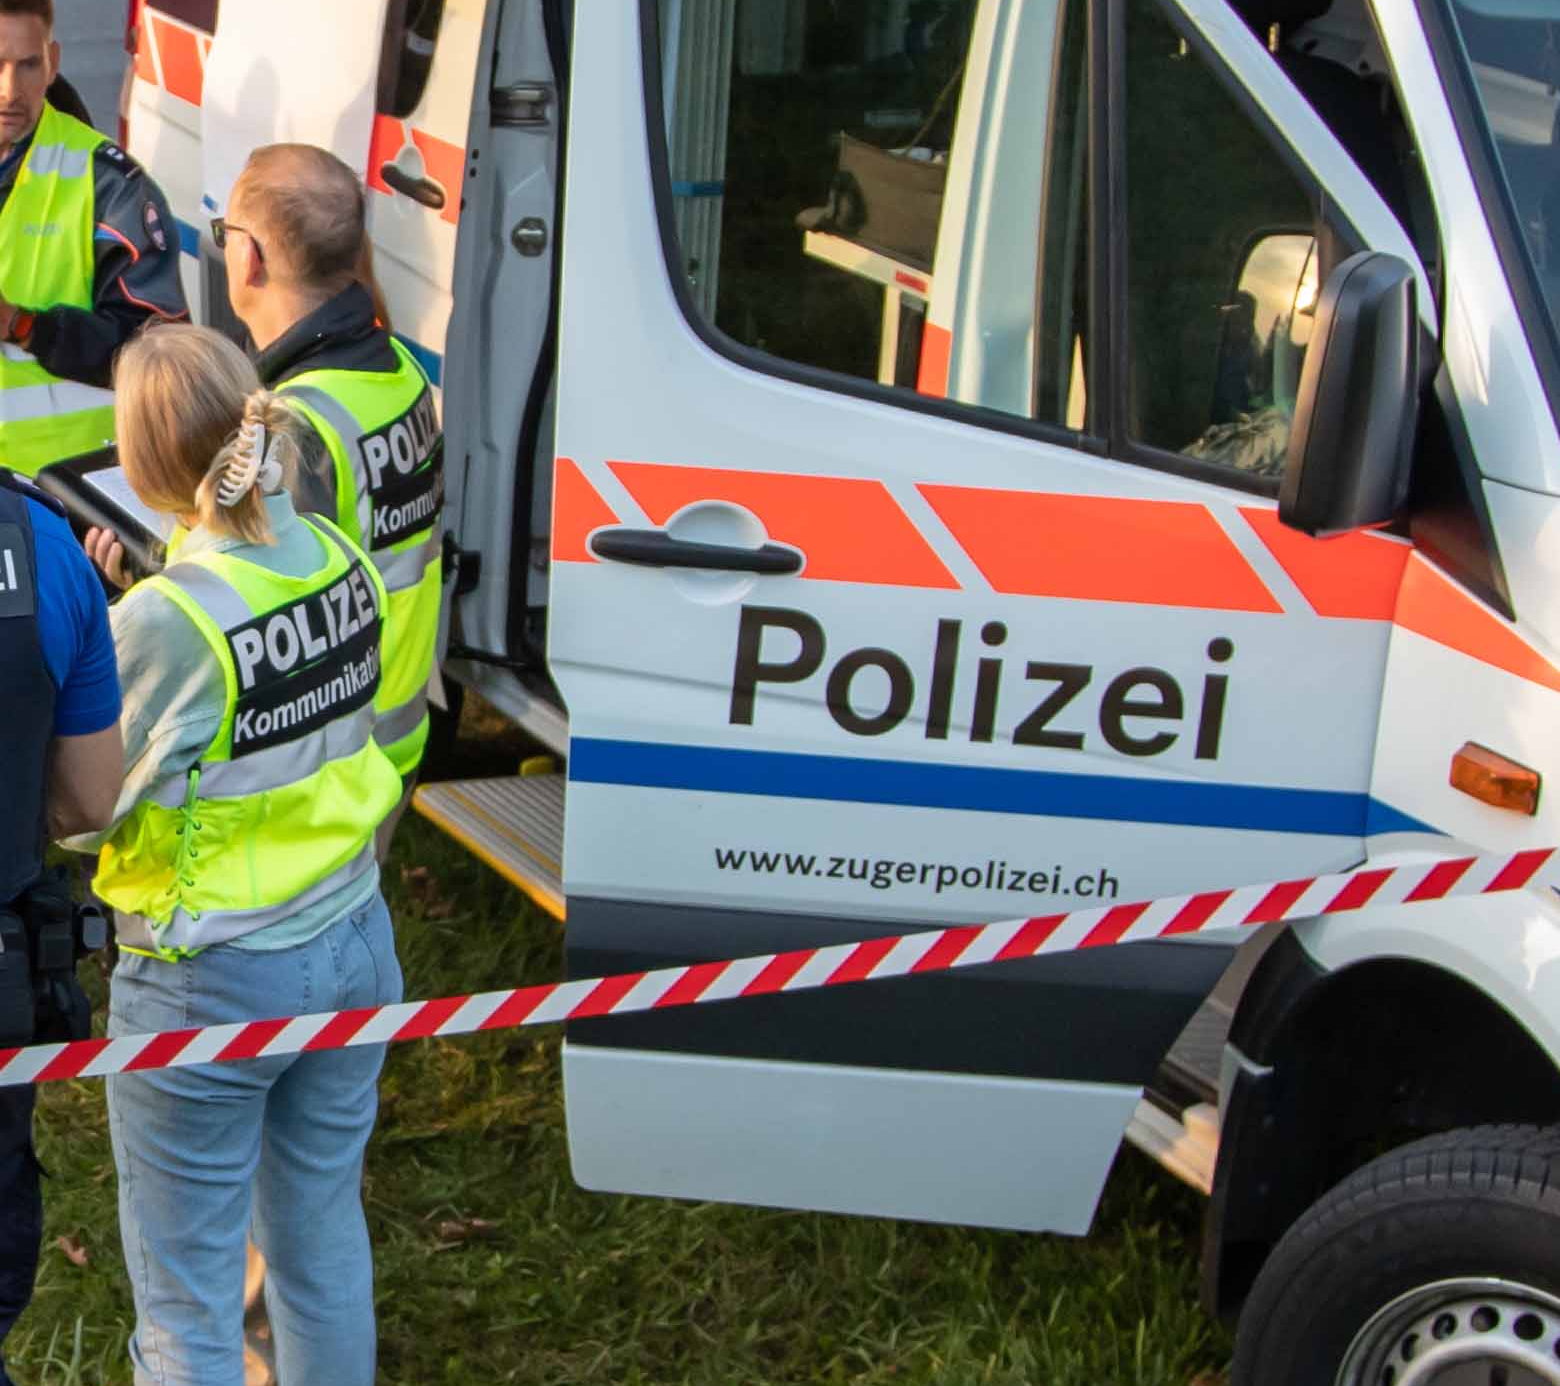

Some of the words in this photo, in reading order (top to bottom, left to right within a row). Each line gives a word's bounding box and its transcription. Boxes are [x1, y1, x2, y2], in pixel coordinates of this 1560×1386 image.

[362, 389, 439, 491] POLIZ
[233, 643, 381, 744] Kommunikati
[729, 604, 1235, 763] Polizei
[713, 842, 1121, 902] www.zugerpolizei.ch
